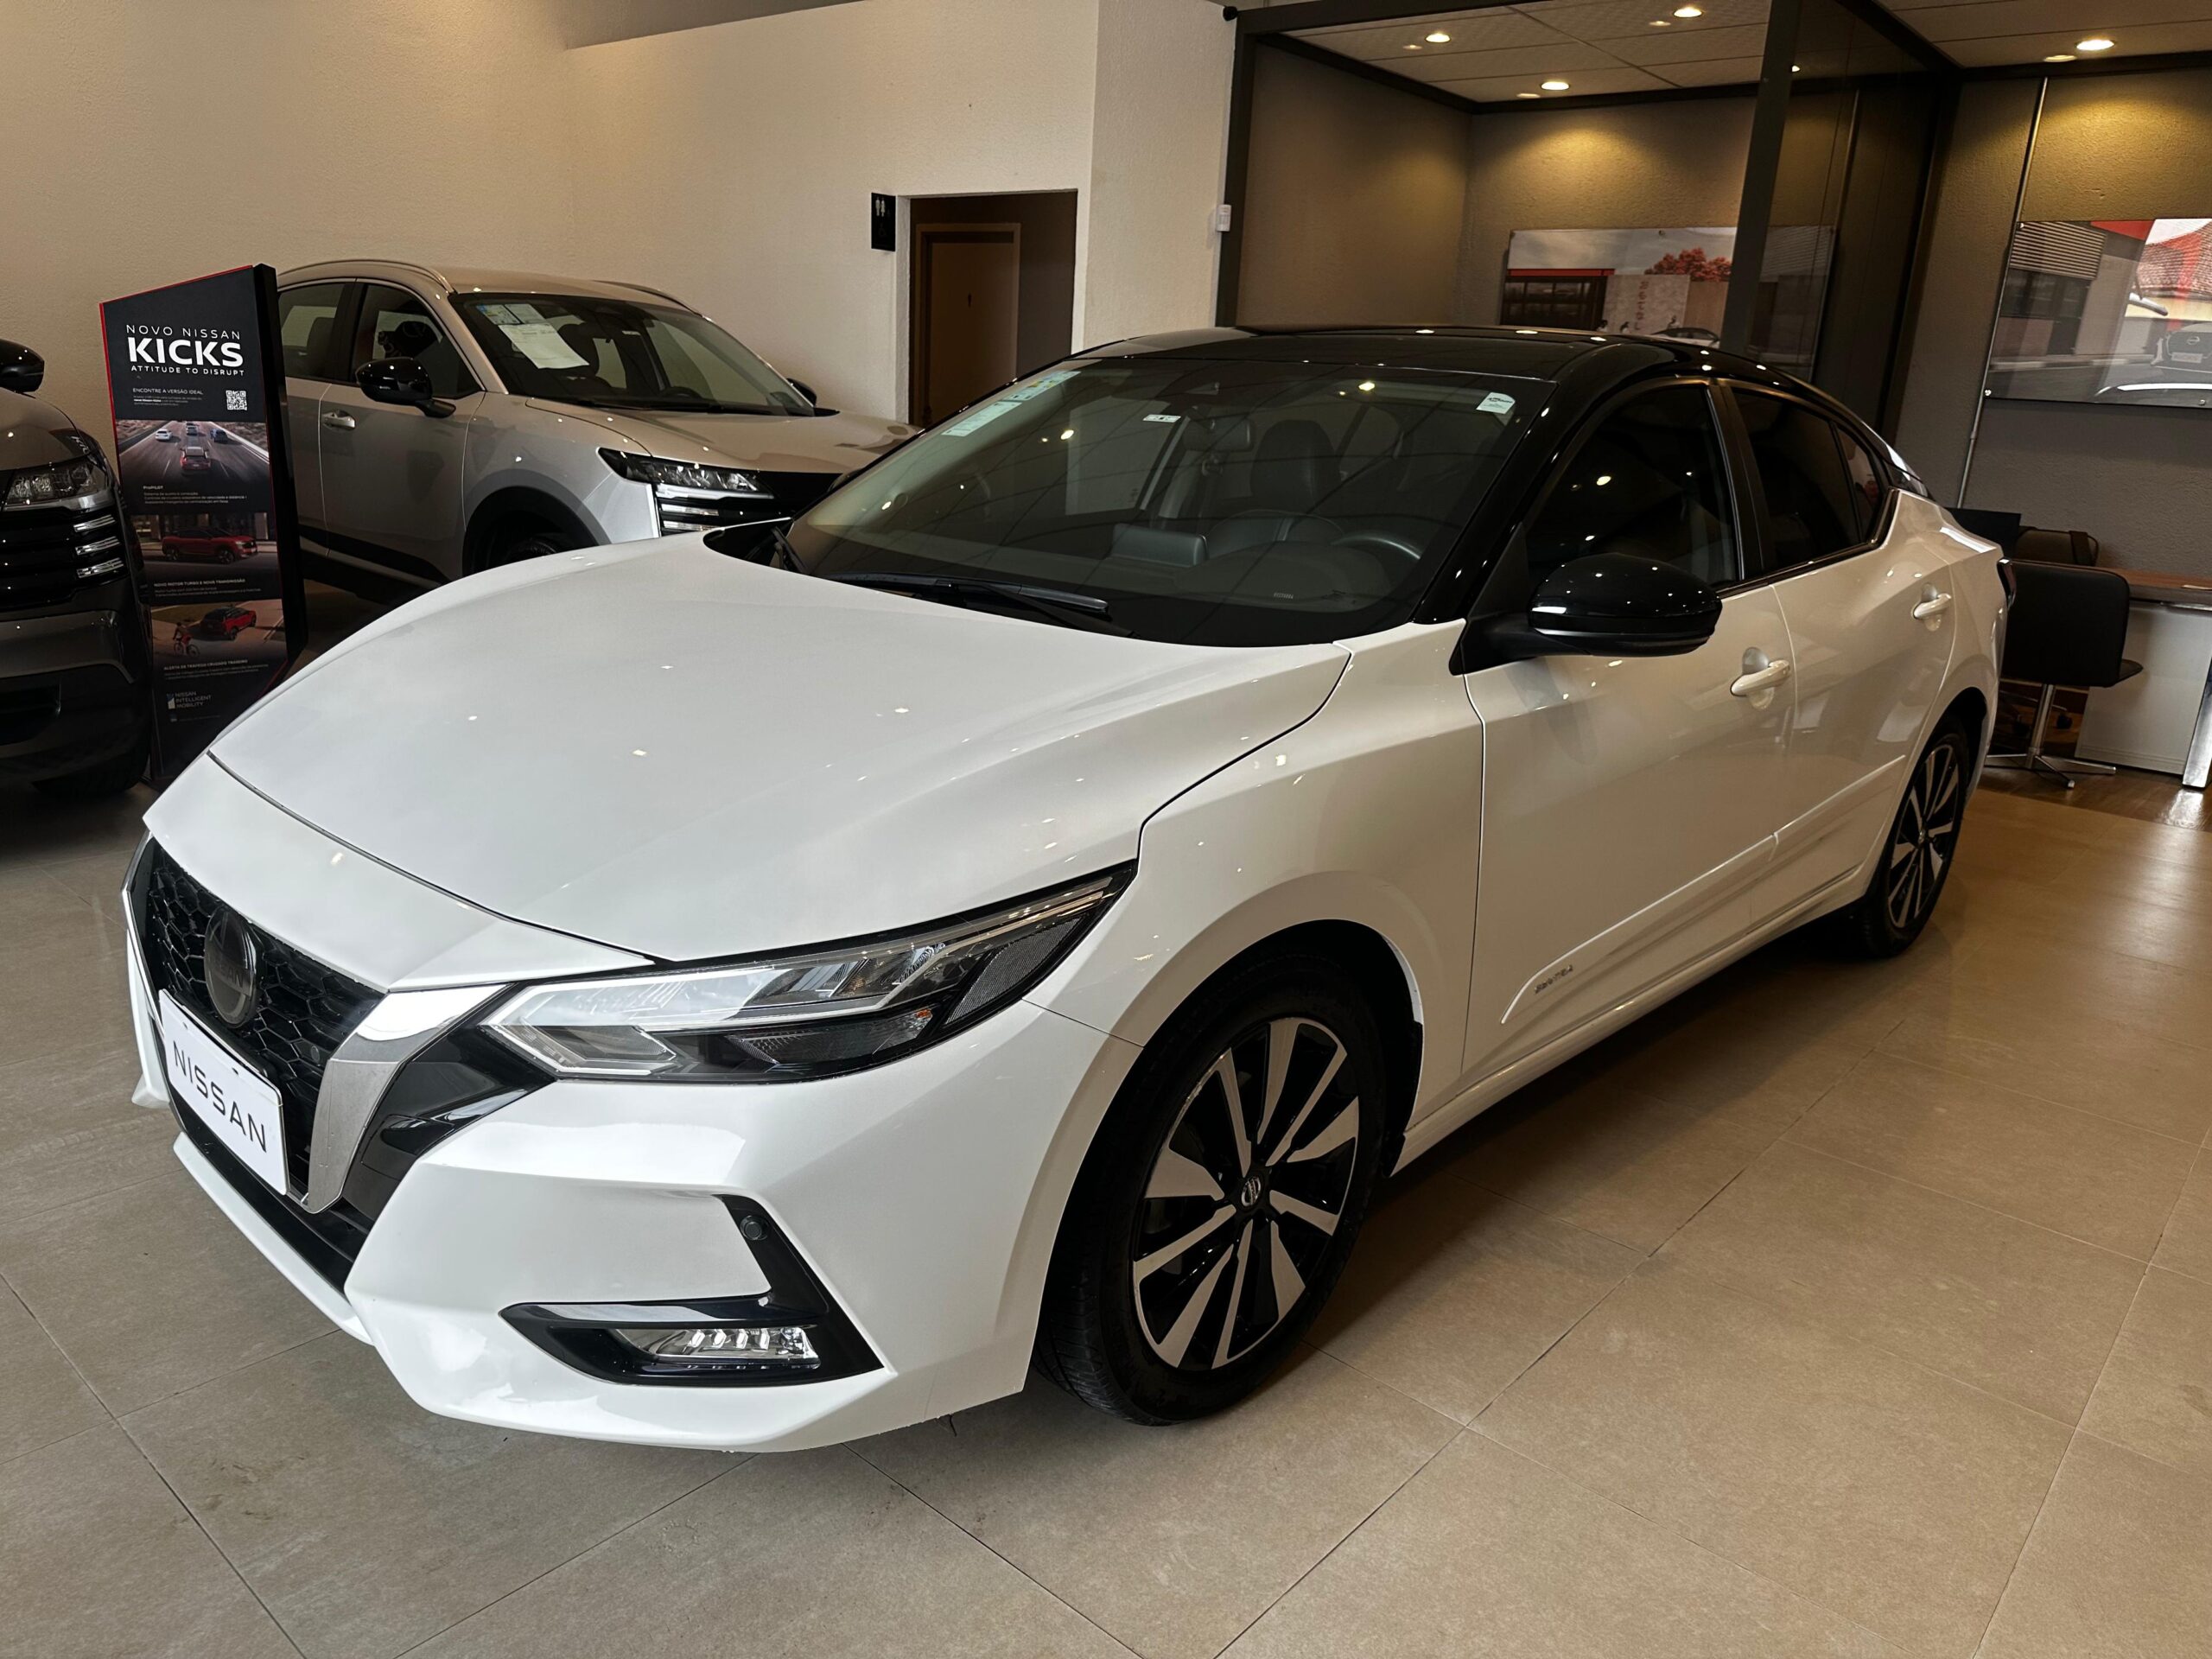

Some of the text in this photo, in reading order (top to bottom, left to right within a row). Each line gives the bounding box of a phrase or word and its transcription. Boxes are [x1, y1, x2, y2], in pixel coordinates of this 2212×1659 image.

[126, 324, 240, 340] NOVO NISSAN
[127, 336, 244, 367] KICKS
[130, 365, 181, 373] ATTITUDE
[203, 368, 245, 377] DISRUPT
[173, 1039, 267, 1154] NISSAN
